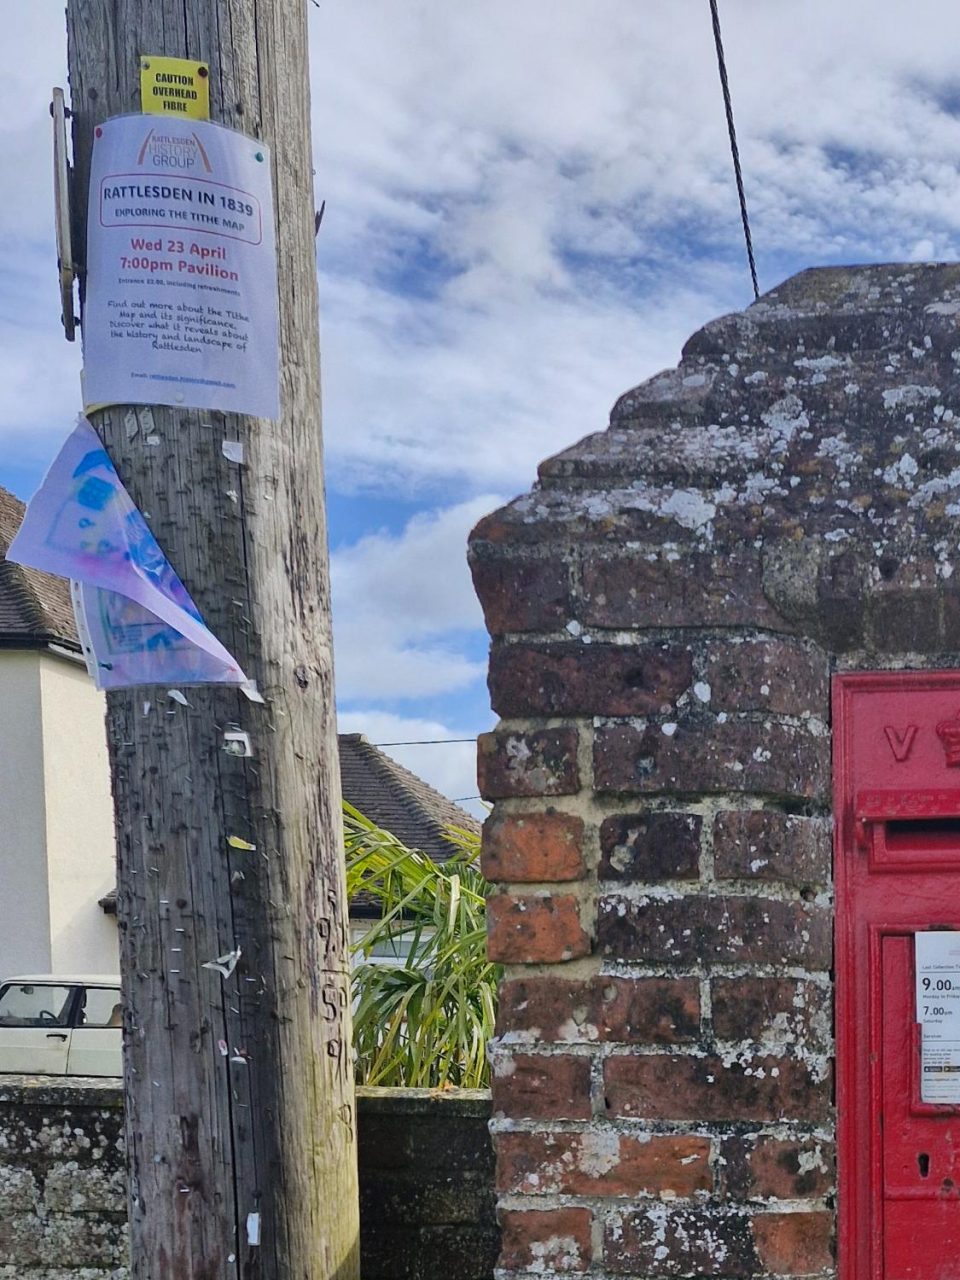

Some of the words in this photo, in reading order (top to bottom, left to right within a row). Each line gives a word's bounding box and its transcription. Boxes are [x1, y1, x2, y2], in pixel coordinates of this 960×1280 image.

[155, 73, 194, 86] CAUTION
[152, 86, 197, 100] OVERHEAD
[163, 100, 188, 112] FIBRE
[149, 143, 199, 156] HISTORY
[152, 135, 196, 147] RATTLESDEN
[152, 154, 195, 169] GROUP
[104, 185, 193, 202] RATTLESDEN
[198, 191, 215, 206] IN
[220, 196, 253, 217] 1839
[115, 208, 166, 218] EXPLORING
[169, 209, 188, 220] THE
[191, 212, 218, 225] TITHE
[222, 219, 245, 231] MAP
[131, 238, 162, 251] Wed
[167, 240, 185, 253] 23
[190, 243, 226, 260] April
[120, 257, 173, 272] 7:00pm
[178, 260, 239, 281] Pavilion
[166, 279, 196, 290] including
[197, 282, 241, 296] refreshments
[108, 300, 127, 308] Find
[131, 301, 146, 309] out
[149, 302, 173, 311] more
[177, 303, 204, 314] about
[207, 307, 222, 317] the
[225, 310, 250, 322] Tithe
[119, 311, 135, 321] Map
[139, 312, 157, 320] and
[160, 313, 173, 321] its
[177, 314, 237, 330] significance.
[109, 320, 145, 329] Discover
[148, 321, 169, 330] what
[173, 322, 181, 331] it
[184, 324, 219, 336] reveals
[221, 329, 249, 342] about
[110, 330, 124, 338] the
[126, 330, 159, 341] history
[161, 332, 181, 342] and
[184, 334, 233, 351] landscape
[236, 343, 247, 352] of
[151, 341, 202, 353] Rattlesden
[883, 724, 920, 763] V
